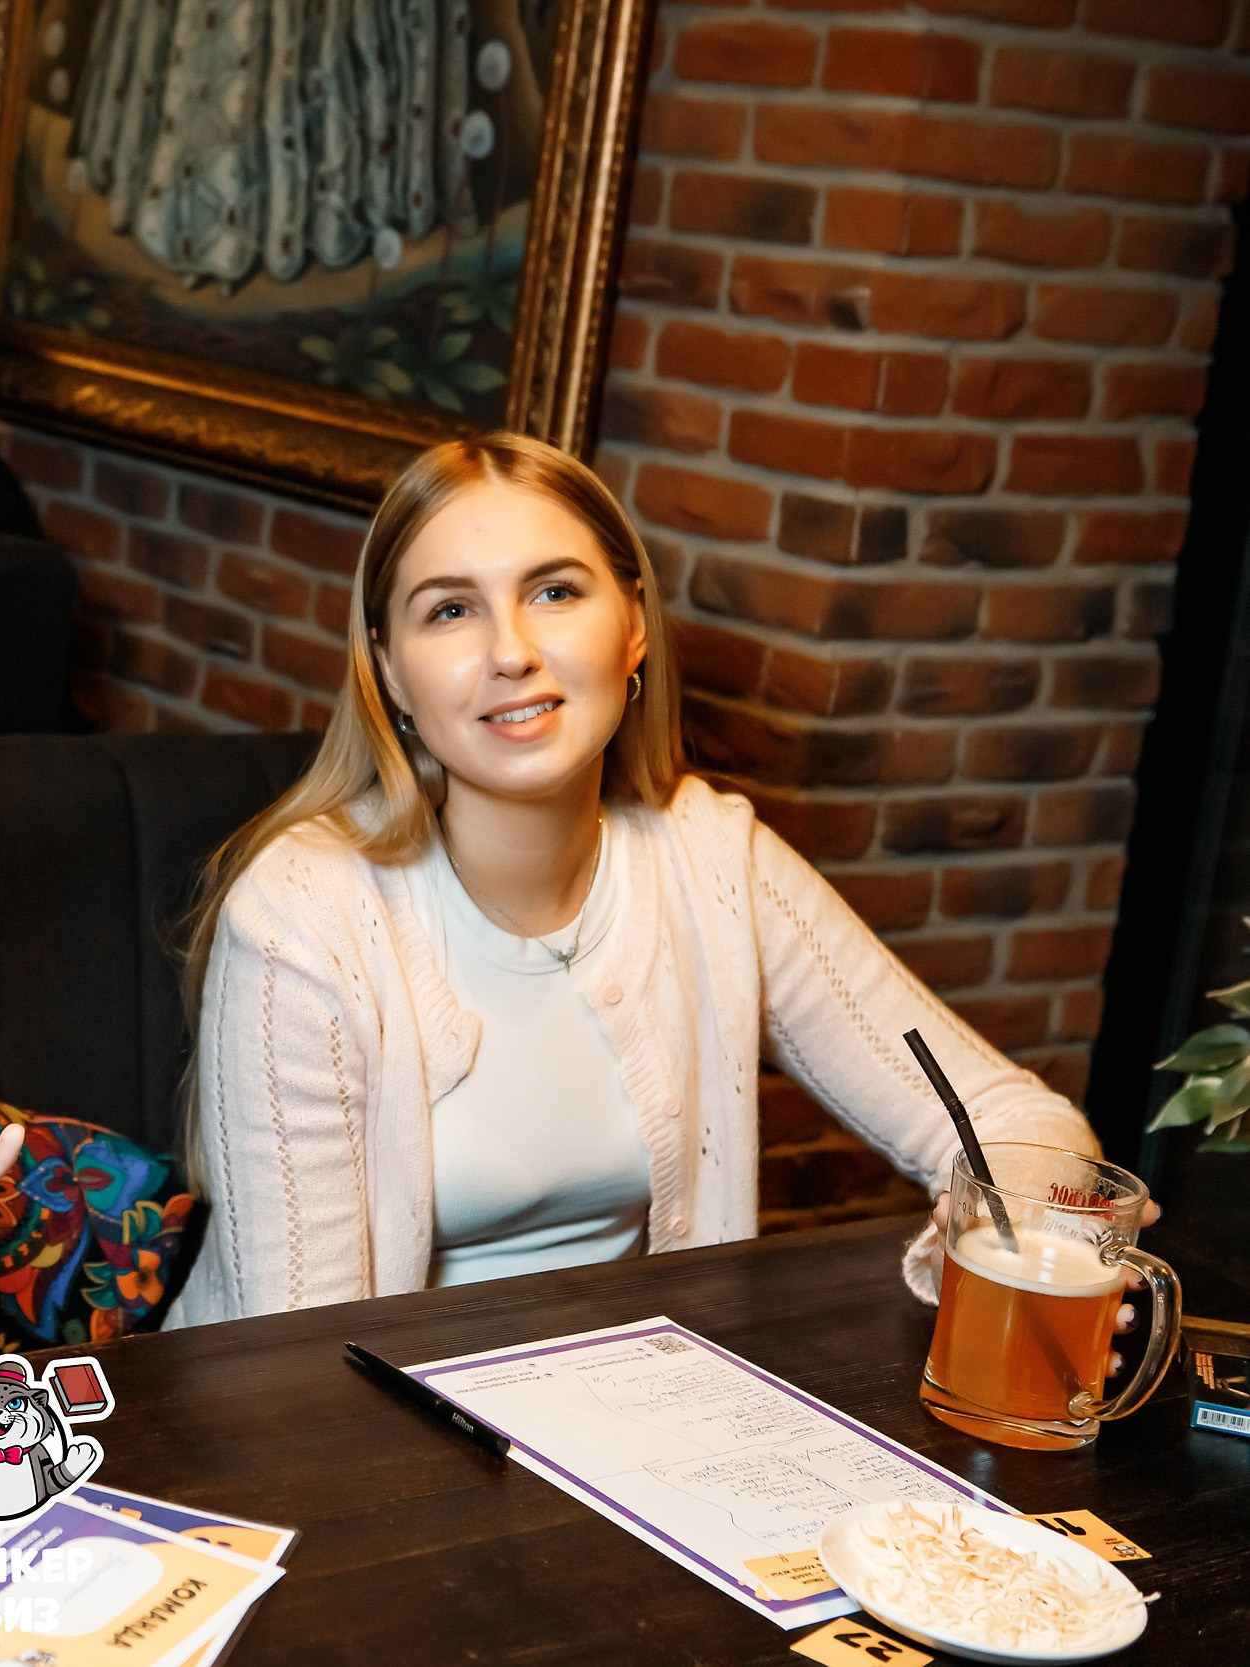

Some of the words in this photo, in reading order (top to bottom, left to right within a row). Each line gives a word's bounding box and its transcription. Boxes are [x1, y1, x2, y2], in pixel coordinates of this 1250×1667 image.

[451, 1411, 475, 1434] Hilton
[105, 1579, 209, 1650] КОМАНДА
[833, 1633, 904, 1663] 27
